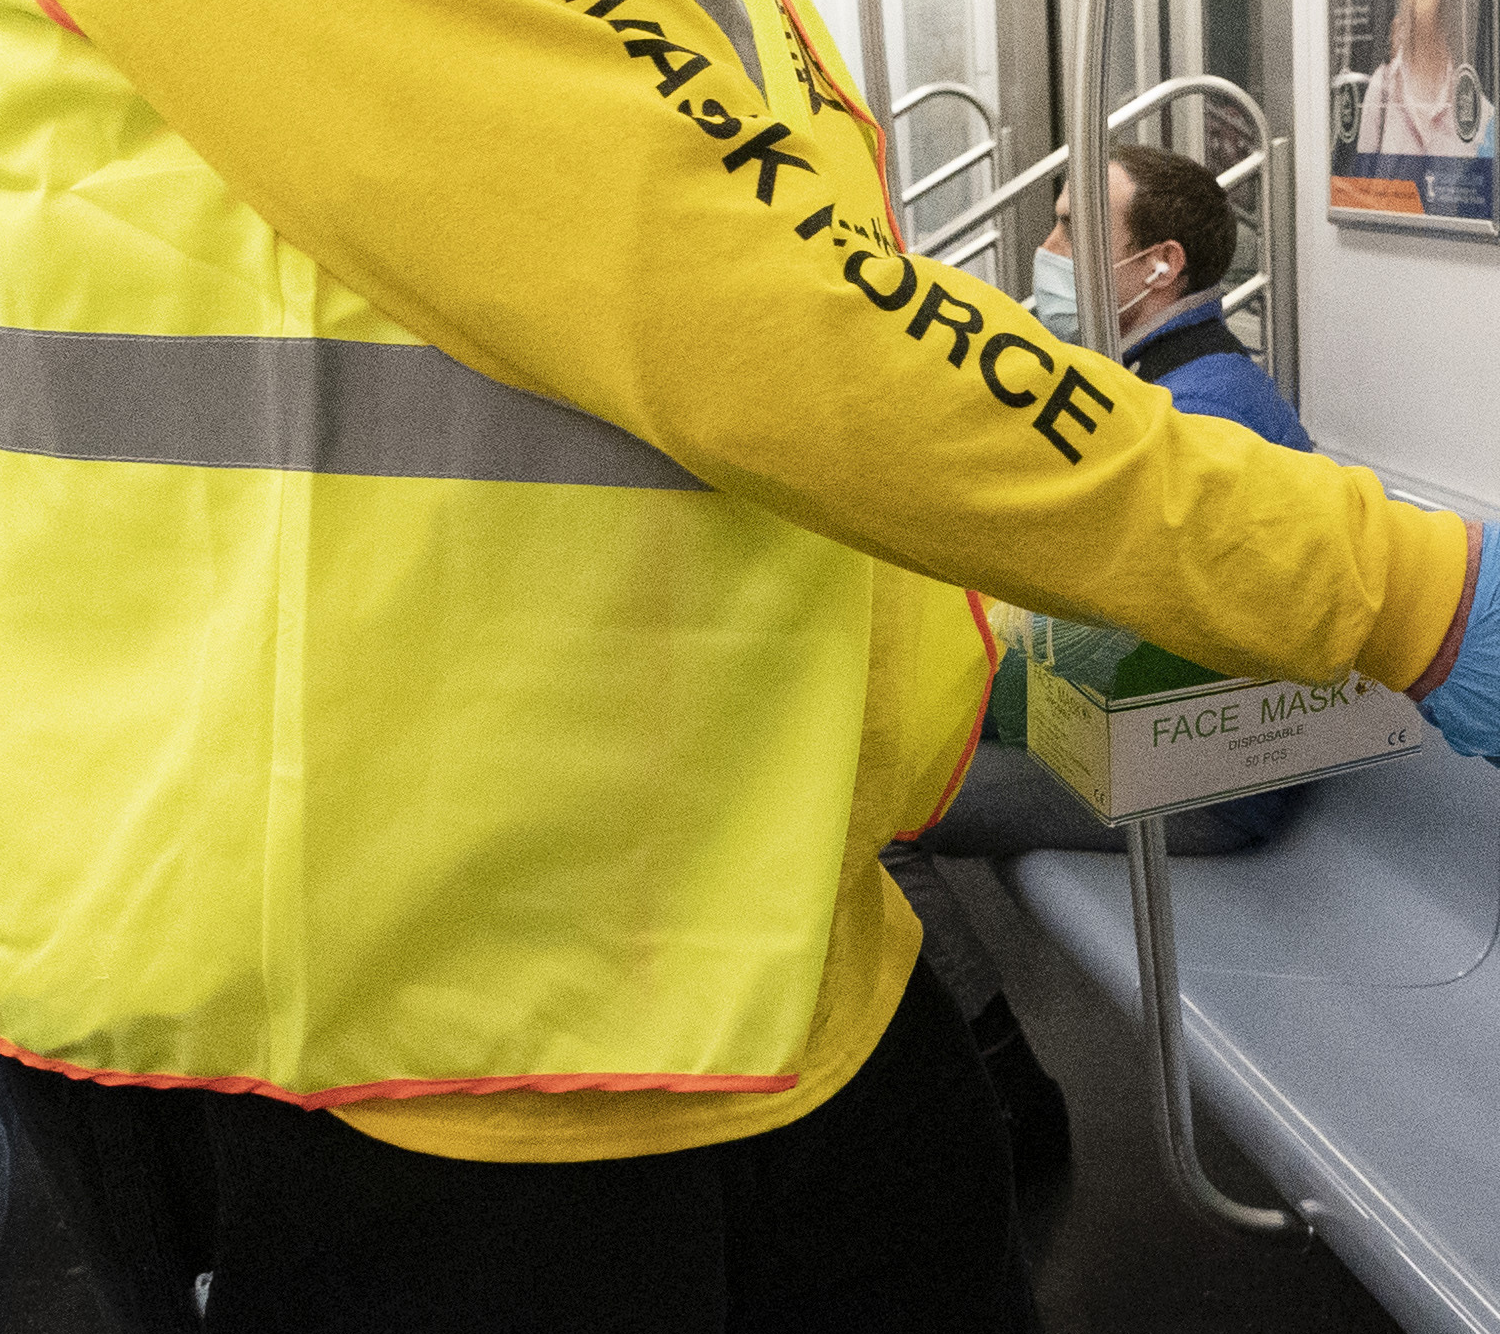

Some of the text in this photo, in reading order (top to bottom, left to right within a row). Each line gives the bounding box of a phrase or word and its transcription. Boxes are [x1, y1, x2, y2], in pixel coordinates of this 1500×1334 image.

[794, 203, 1115, 467] FORCE
[1151, 684, 1350, 748] FACE MASK
[1228, 724, 1305, 751] DISPOSABLE
[1262, 747, 1289, 766] PCS
